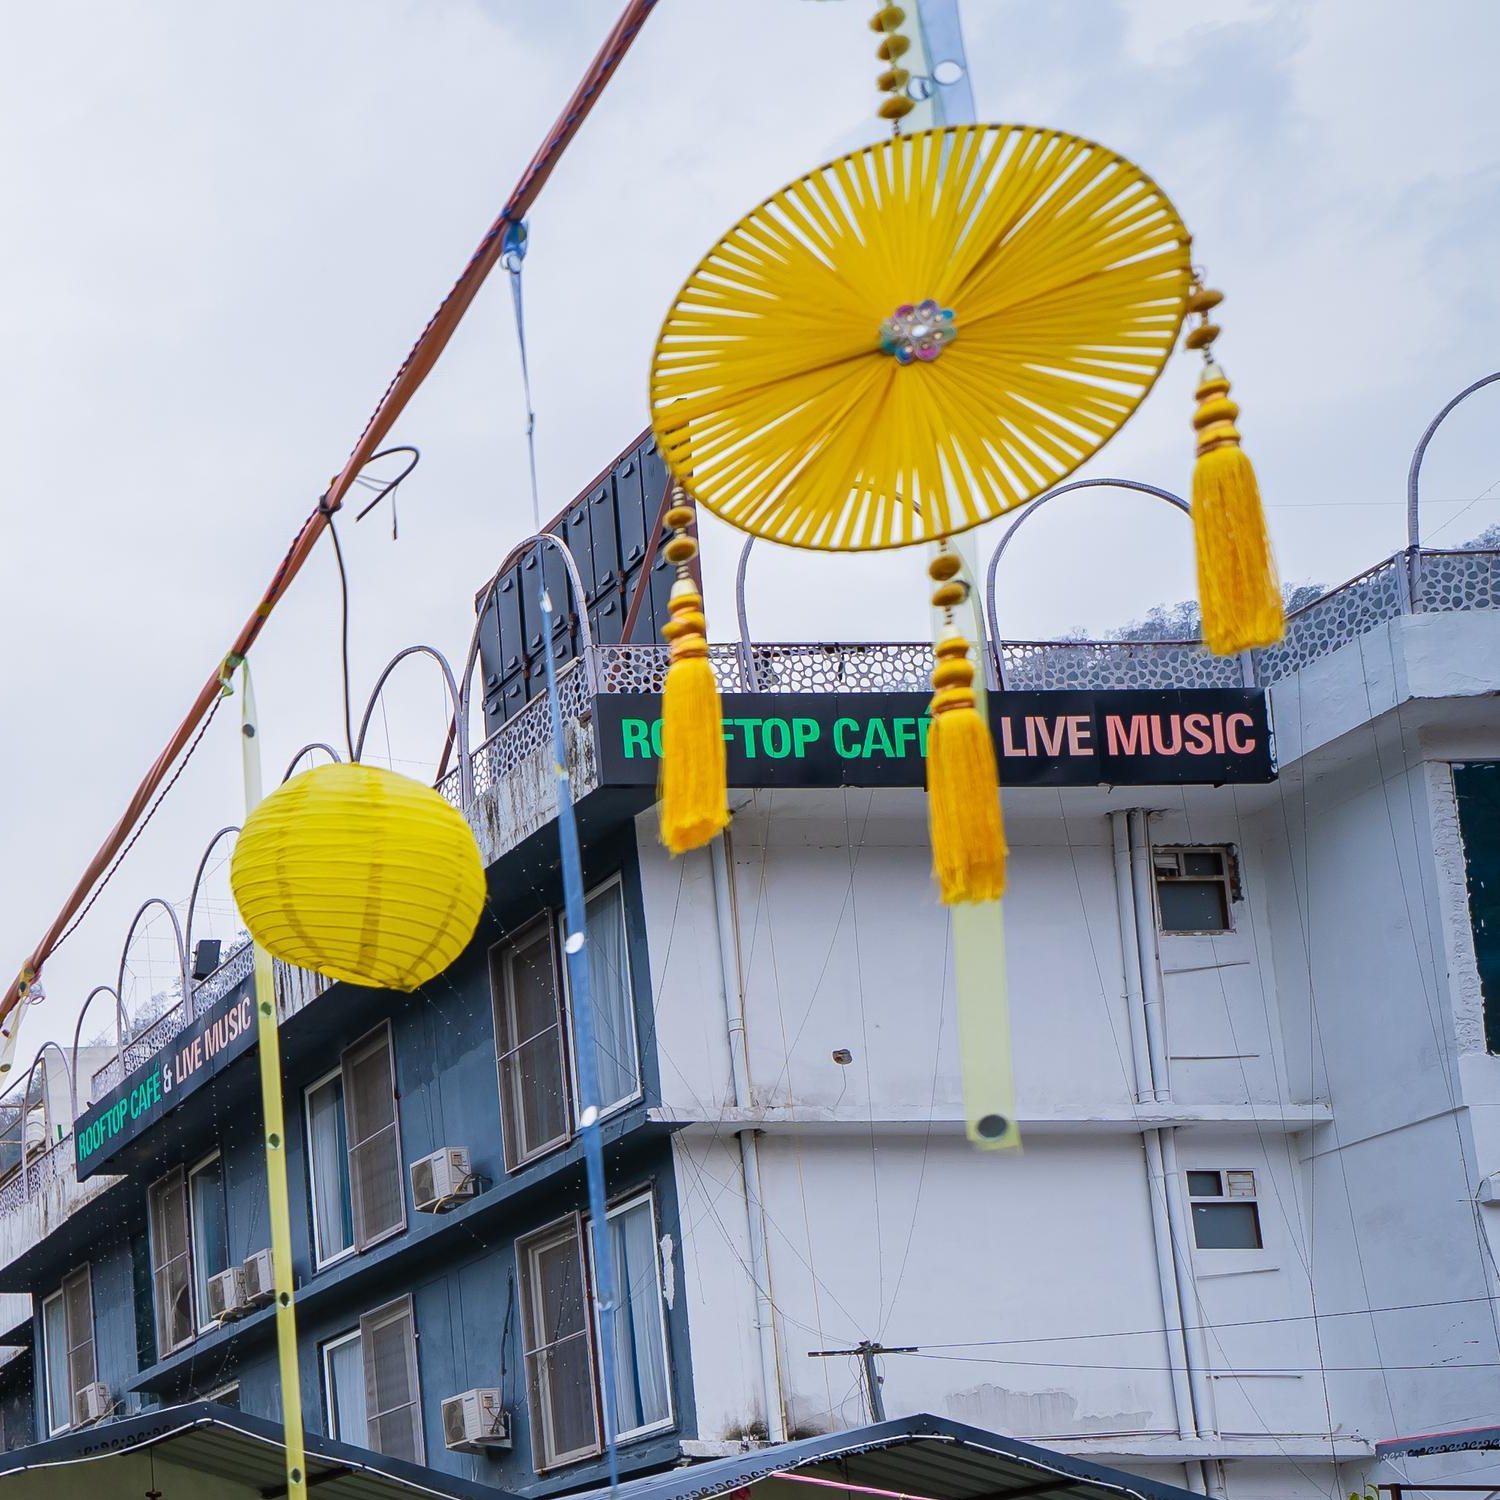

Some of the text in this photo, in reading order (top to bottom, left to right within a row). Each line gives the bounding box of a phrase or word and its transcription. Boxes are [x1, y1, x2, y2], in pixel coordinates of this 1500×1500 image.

[620, 717, 821, 760] RTOP
[1000, 714, 1095, 758] LIVE
[1104, 712, 1256, 757] MUSIC
[78, 996, 251, 1162] ROOFTOP CAFÉ & LIVE MUSIC
